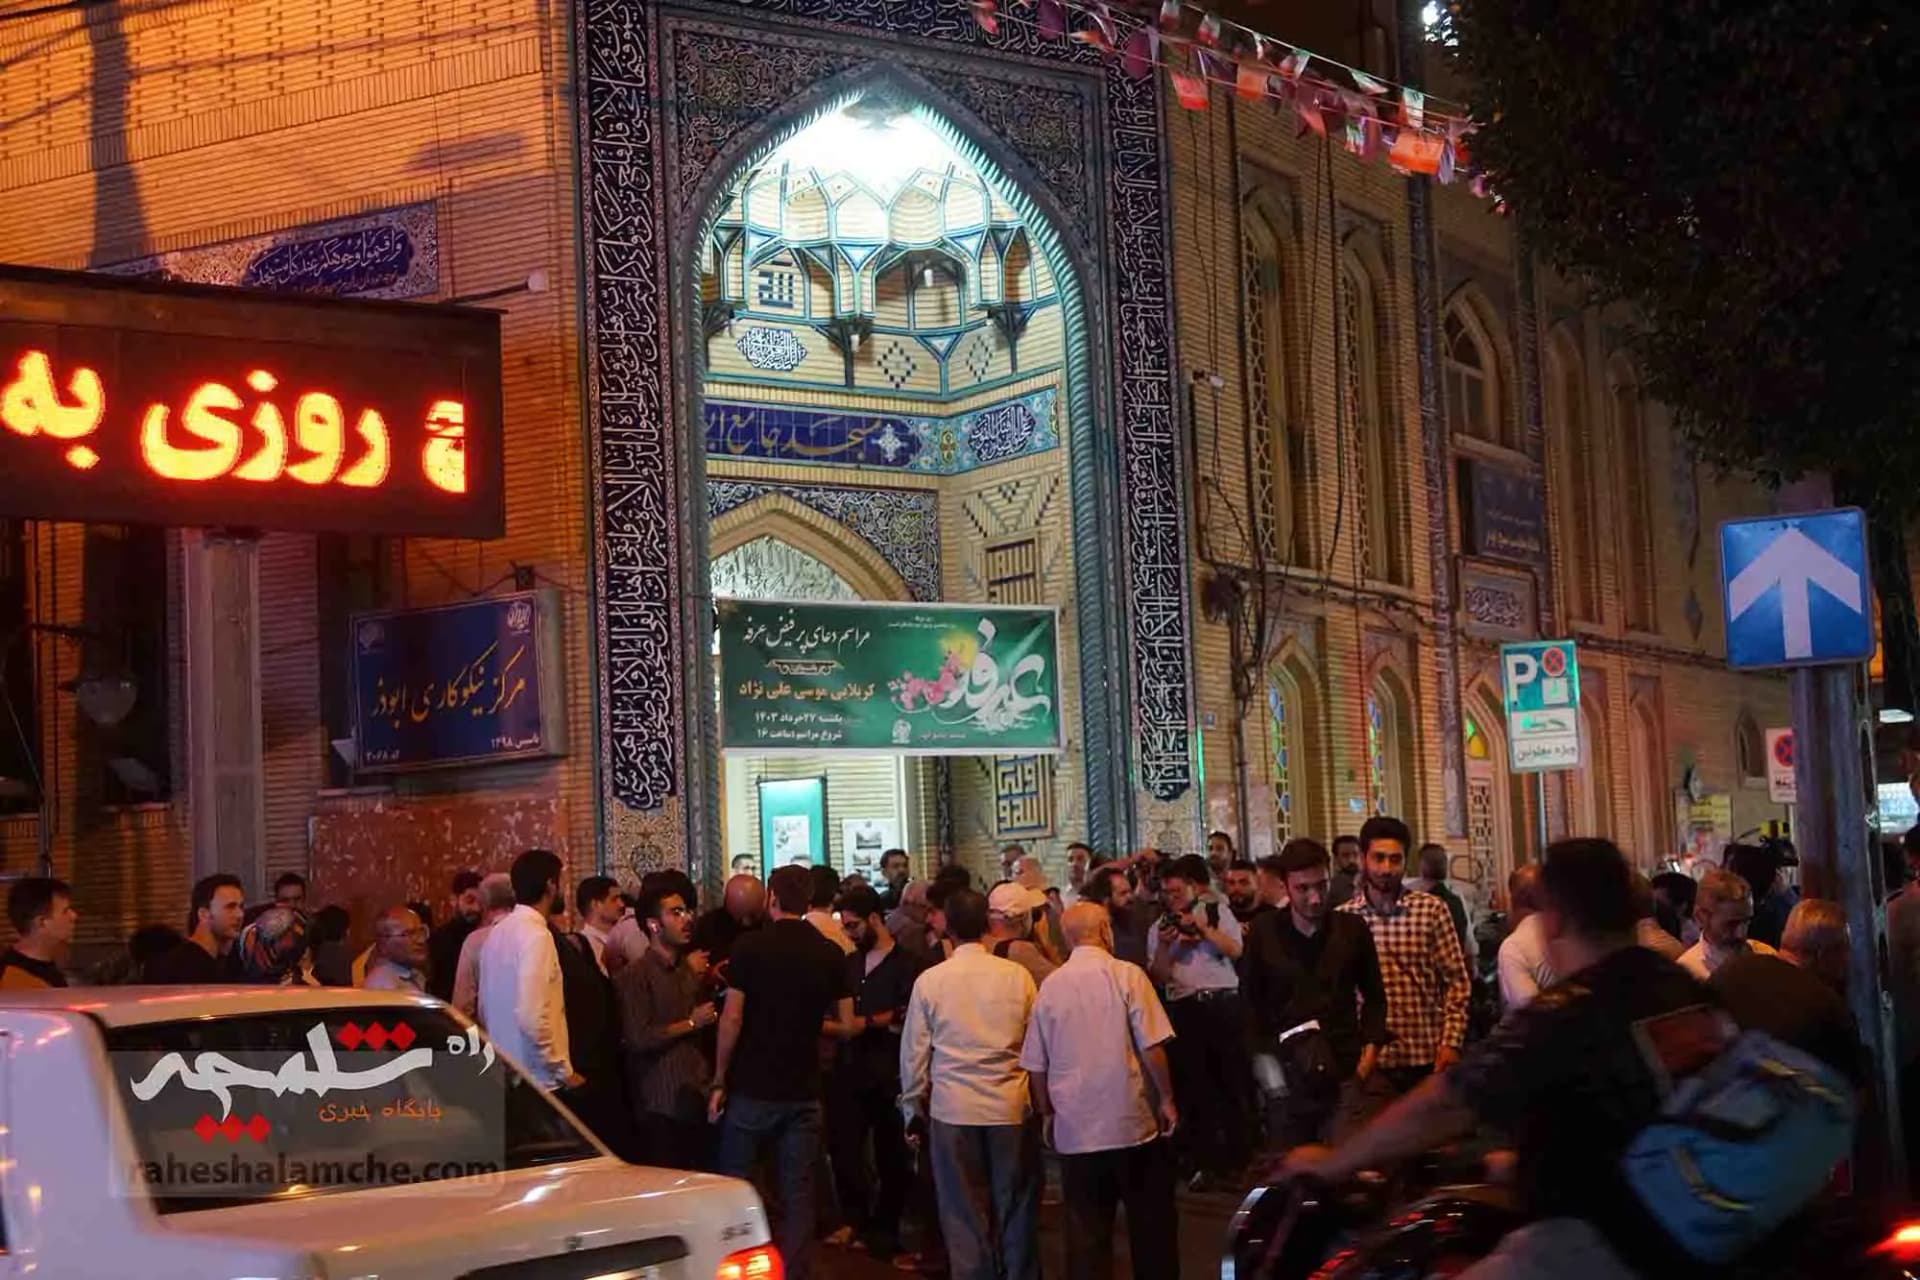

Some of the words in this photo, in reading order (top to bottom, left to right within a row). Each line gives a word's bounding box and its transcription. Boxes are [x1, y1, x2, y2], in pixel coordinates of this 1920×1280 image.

[140, 368, 391, 487] روزی
[742, 615, 767, 644] عرفه
[804, 625, 837, 648] دعای
[837, 626, 870, 655] مراسم
[488, 645, 526, 715] مرکز
[738, 680, 764, 700] نژاد
[766, 681, 791, 700] علی
[831, 682, 875, 702] کربلایی
[1505, 654, 1538, 702] P
